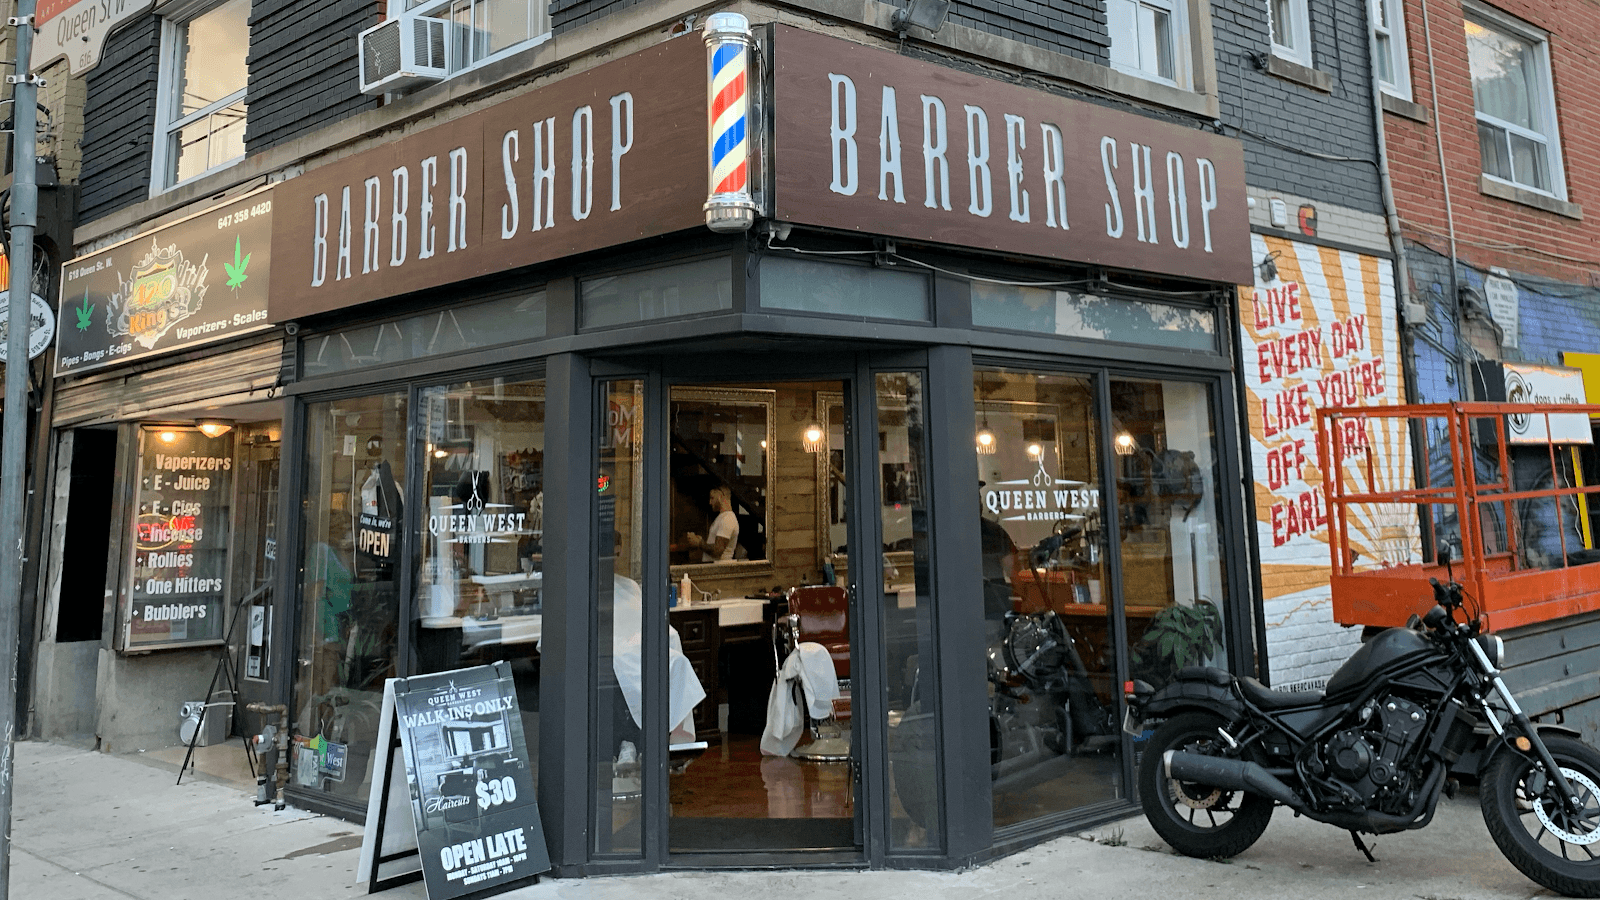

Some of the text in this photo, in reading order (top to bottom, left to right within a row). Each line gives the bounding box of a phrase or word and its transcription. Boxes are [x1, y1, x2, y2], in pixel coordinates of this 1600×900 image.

[57, 5, 95, 47] Queen
[79, 50, 92, 68] 616
[827, 72, 1218, 253] BARBER SHOP
[311, 93, 634, 288] BARBER SHOP
[217, 200, 272, 230] 647 358 4420
[1253, 282, 1302, 331] LIVE
[176, 309, 268, 340] Vaporizers Scales
[61, 342, 132, 369] Pipes Bongs E-cigs
[1257, 314, 1365, 385] EVERY DAY
[1262, 358, 1385, 438] LIKE YOU'RE
[156, 451, 232, 472] Vaperizers
[1266, 439, 1306, 491] OFF
[154, 475, 163, 491] E
[174, 475, 211, 490] Juice
[152, 500, 161, 516] E
[172, 500, 202, 516] Cigs
[986, 489, 1099, 514] QUEEN WEST
[1271, 479, 1335, 548] EARL
[429, 513, 525, 537] QUEEN WEST
[1027, 511, 1065, 521] BARBERS
[150, 526, 203, 542] Incense
[360, 528, 390, 557] OPEN
[459, 535, 491, 544] BARBERS
[148, 552, 193, 568] Rollies
[146, 576, 222, 595] One Hitters
[144, 603, 207, 622] Bubblers
[427, 694, 456, 706] QUEEN
[458, 689, 482, 699] WEST
[403, 695, 513, 728] WALK-INS ONLY
[424, 795, 470, 814] Haircuts
[475, 776, 517, 810] $30
[440, 827, 528, 871] OPEN LATE
